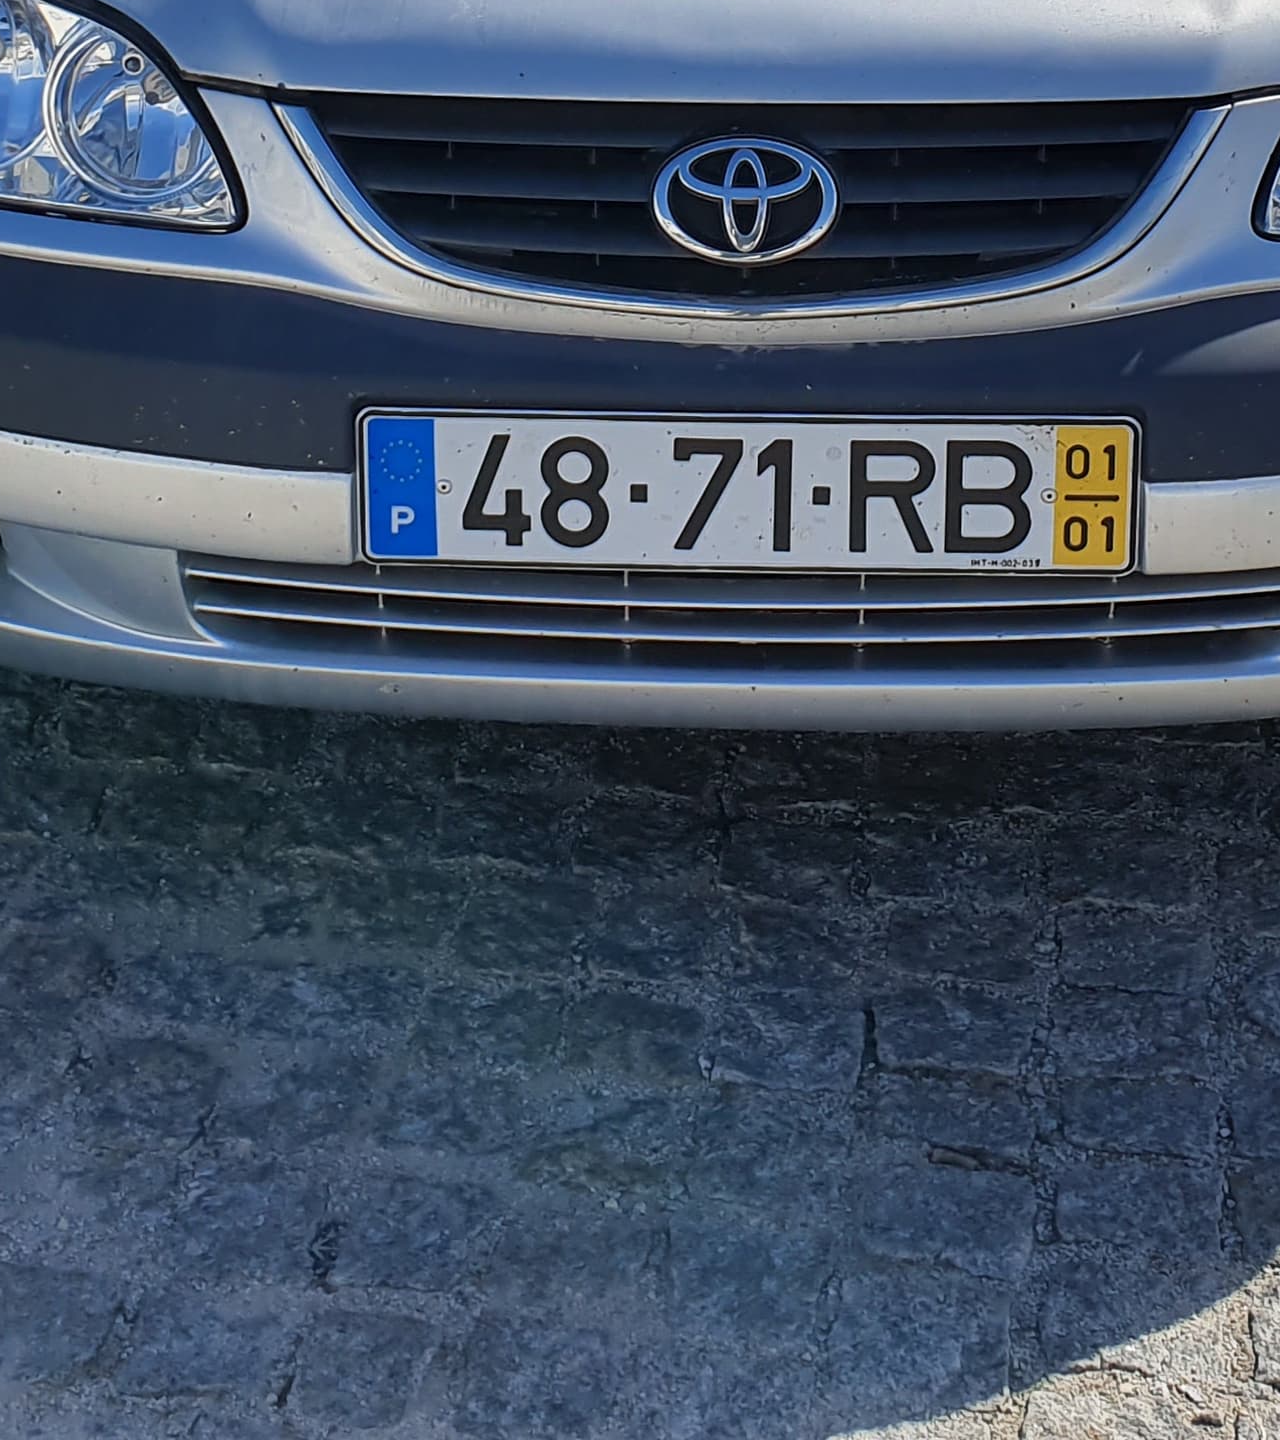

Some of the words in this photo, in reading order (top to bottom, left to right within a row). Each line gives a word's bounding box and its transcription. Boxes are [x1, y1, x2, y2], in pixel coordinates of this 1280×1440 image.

[1065, 443, 1116, 481] 01
[390, 505, 416, 535] P
[1063, 515, 1115, 553] 01
